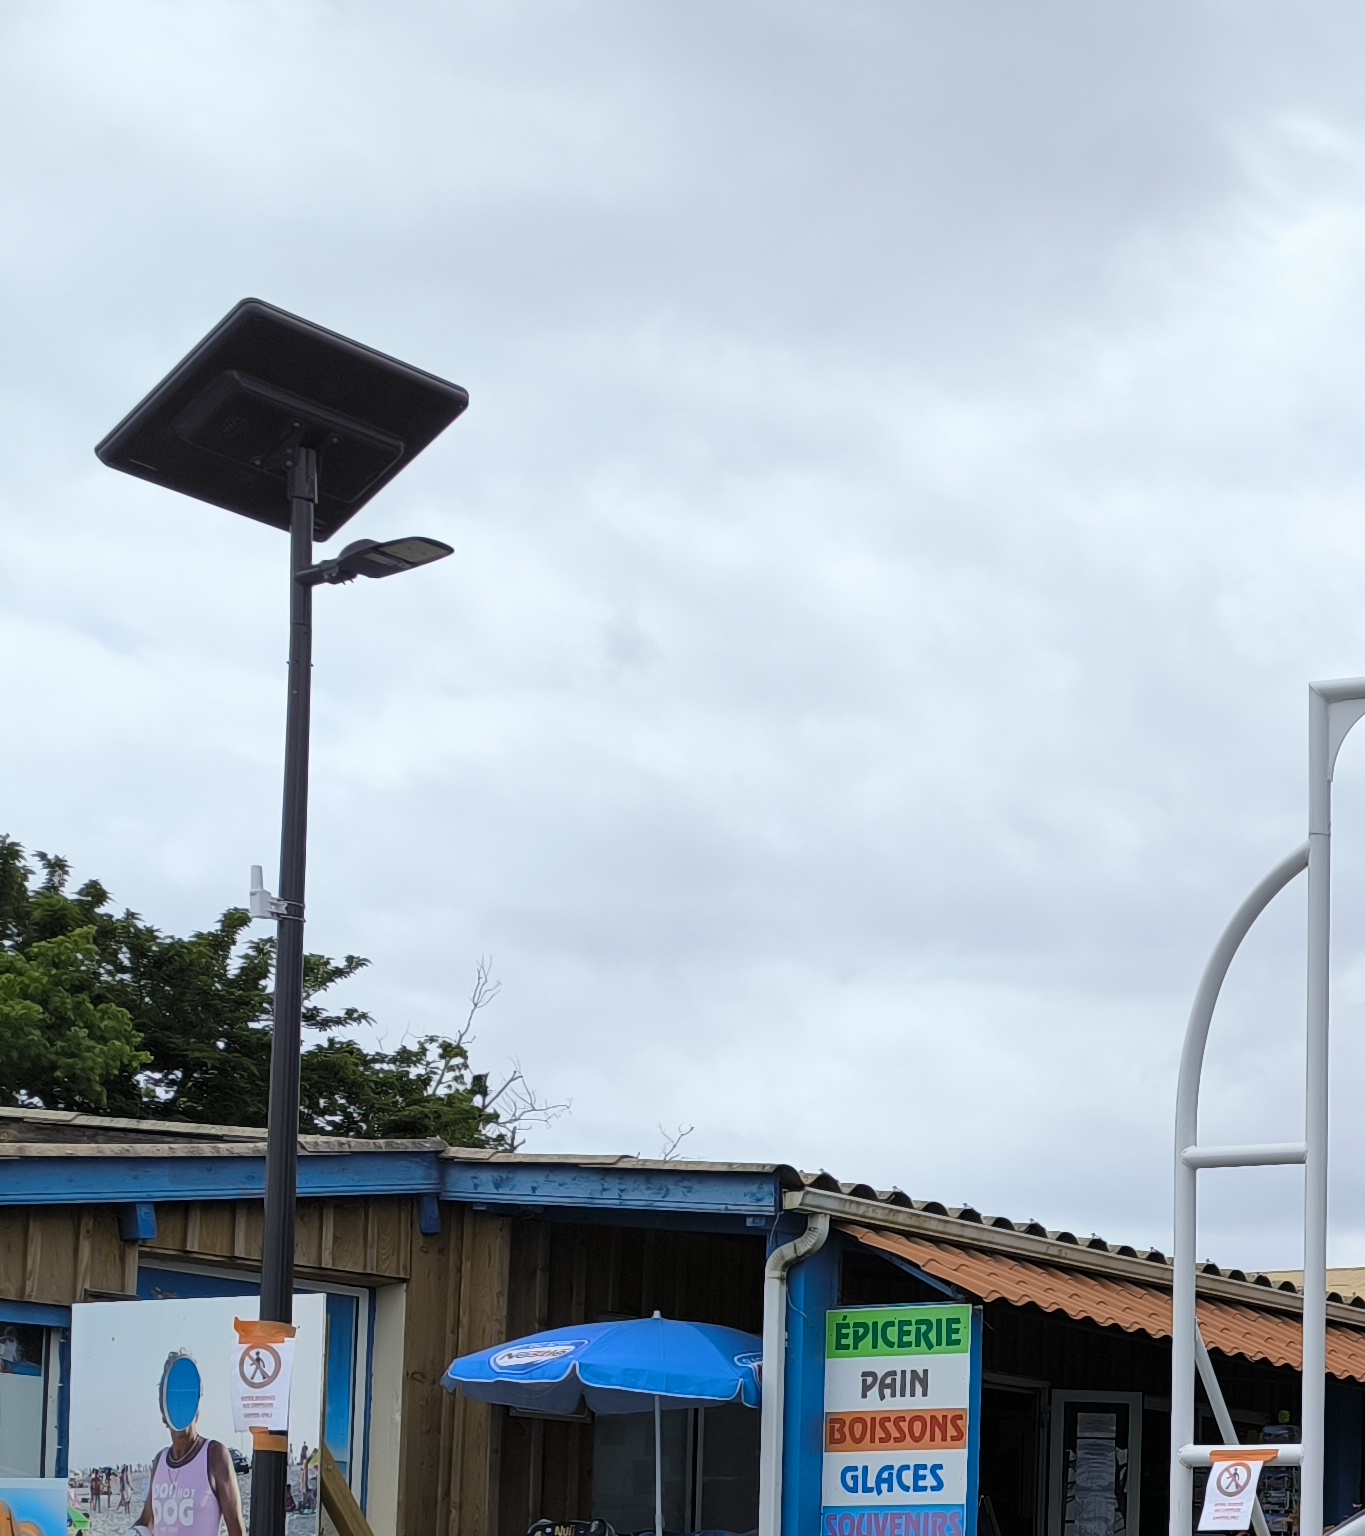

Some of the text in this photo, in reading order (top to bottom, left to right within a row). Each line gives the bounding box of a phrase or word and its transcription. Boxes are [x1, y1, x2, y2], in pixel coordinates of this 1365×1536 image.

[835, 1315, 962, 1351] ÉPICERIE
[860, 1368, 929, 1401] PAIN
[828, 1414, 965, 1445] BOISSONS
[840, 1463, 945, 1496] GLACES
